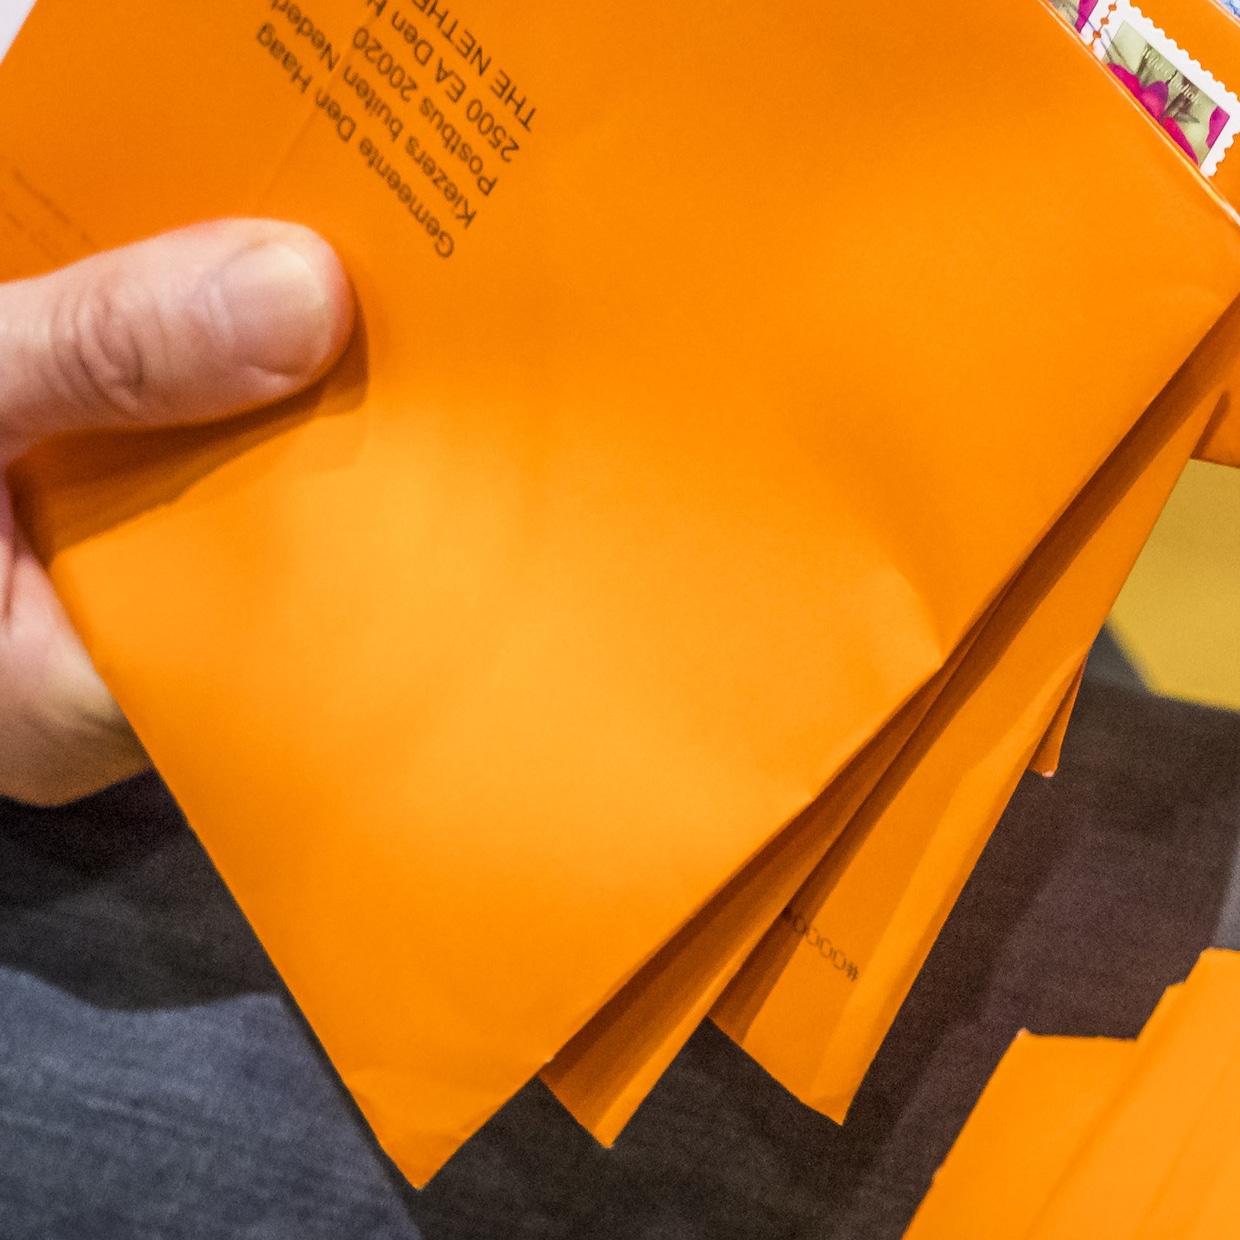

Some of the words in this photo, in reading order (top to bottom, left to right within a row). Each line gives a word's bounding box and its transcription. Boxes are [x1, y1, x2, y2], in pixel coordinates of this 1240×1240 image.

[257, 22, 312, 94] Haag
[353, 26, 418, 102] 20020
[391, 11, 434, 67] Den
[315, 87, 356, 142] Den
[343, 66, 403, 142] buiten
[436, 57, 467, 103] EA
[489, 69, 536, 132] THE
[419, 96, 498, 196] Postbus
[466, 98, 520, 162] 2500
[359, 137, 455, 258] Gemeente
[405, 135, 477, 229] Kiezers
